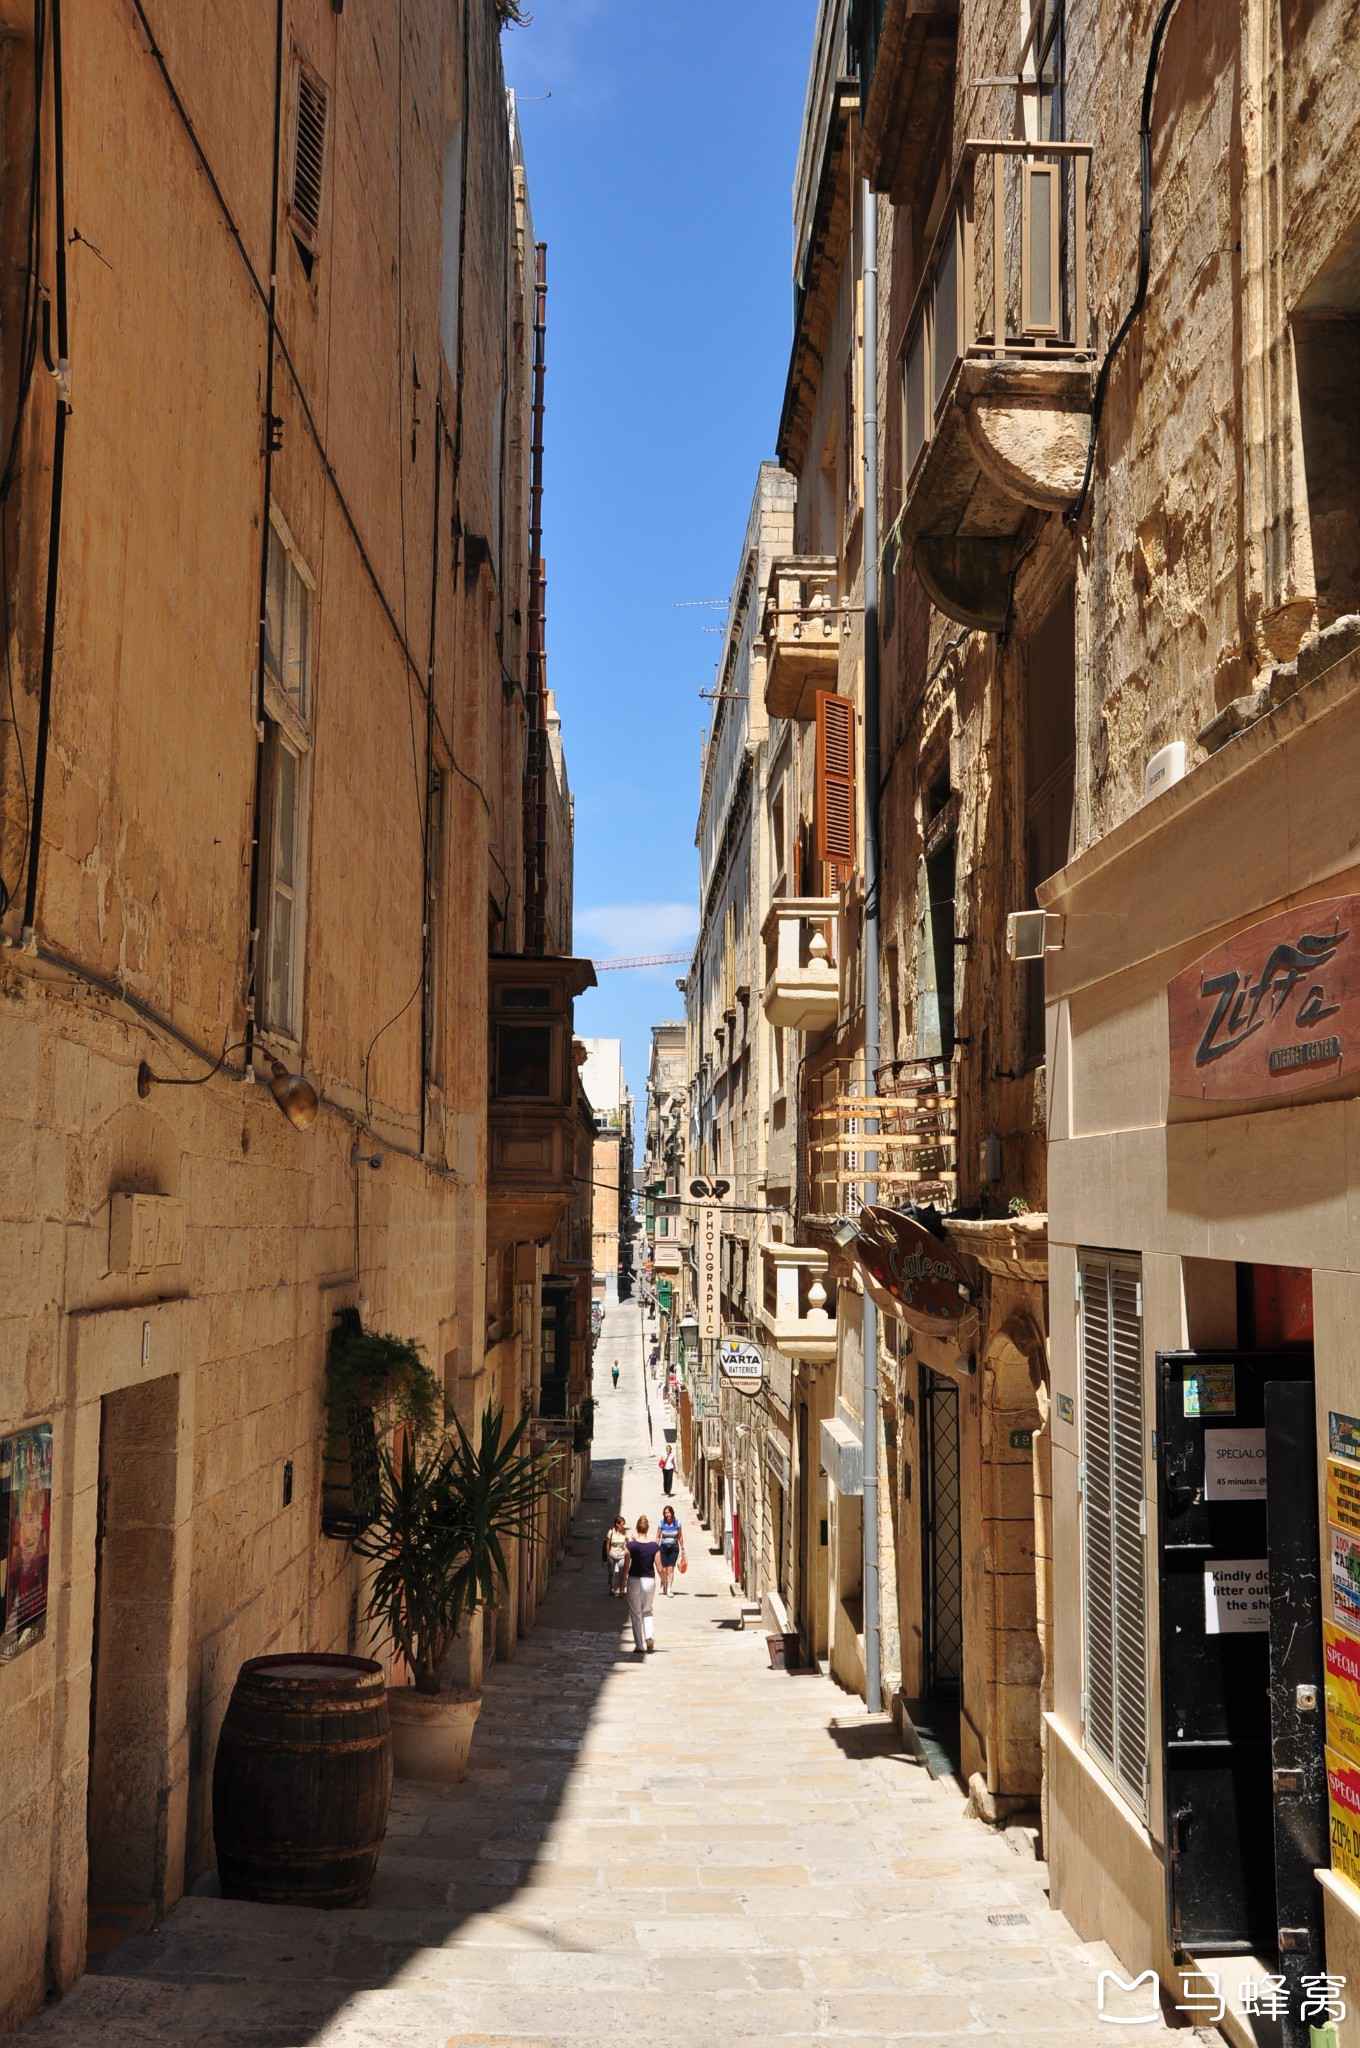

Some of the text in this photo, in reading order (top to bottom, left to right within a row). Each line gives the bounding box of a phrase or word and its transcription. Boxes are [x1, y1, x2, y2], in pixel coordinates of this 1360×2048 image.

[706, 1211, 714, 1335] PHOTOGRAPHIC
[722, 1355, 761, 1364] VARTA
[1216, 1448, 1253, 1459] SPECIAL
[1227, 1478, 1257, 1486] minutes
[1212, 1570, 1252, 1583] Kindly
[1213, 1585, 1244, 1596] litter
[1226, 1600, 1248, 1611] the
